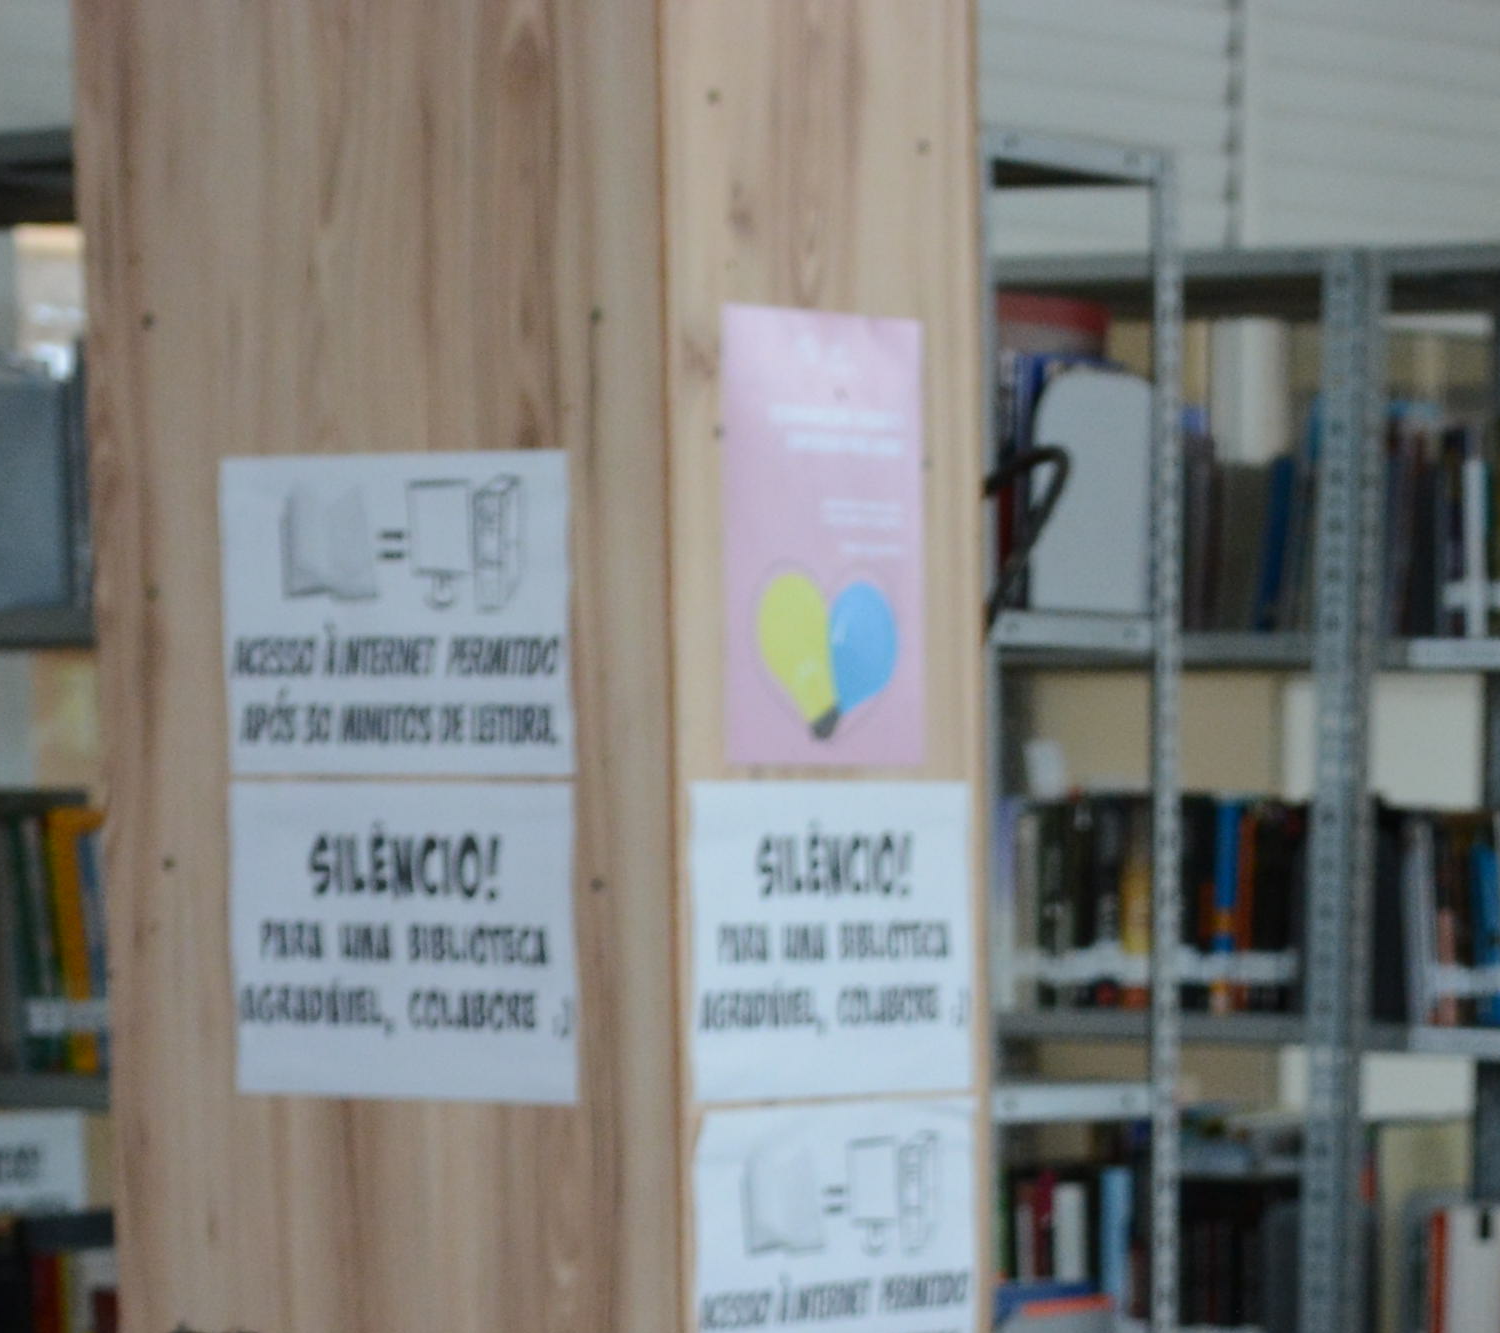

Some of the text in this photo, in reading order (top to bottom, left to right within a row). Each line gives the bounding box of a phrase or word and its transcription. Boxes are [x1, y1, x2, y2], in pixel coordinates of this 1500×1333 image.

[341, 704, 432, 744] MINUTOS
[439, 704, 465, 744] DE
[308, 818, 501, 902] SILÊNCIO!
[259, 919, 549, 966] PARA UMA BIBLIOTECA
[407, 989, 537, 1031] COLABORE
